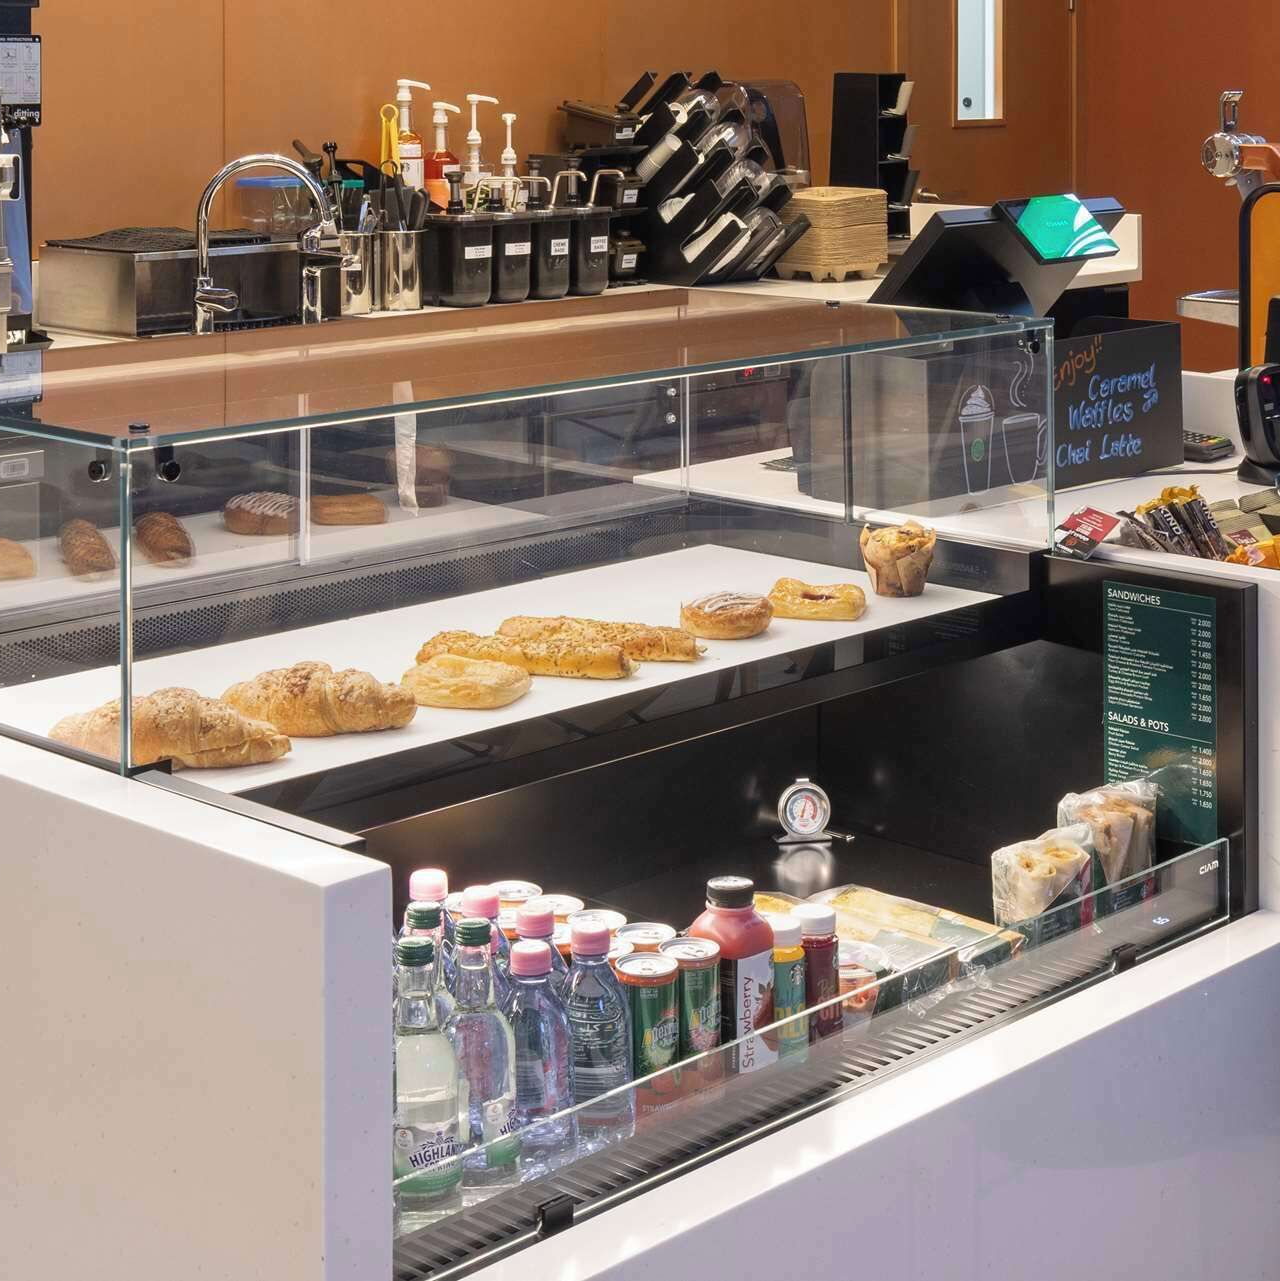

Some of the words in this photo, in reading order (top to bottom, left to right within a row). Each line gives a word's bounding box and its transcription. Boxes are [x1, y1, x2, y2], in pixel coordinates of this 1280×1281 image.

[14, 109, 40, 119] ditting
[1089, 360, 1156, 401] Caramel
[1069, 398, 1134, 431] Waffles
[1056, 439, 1091, 468] Chai
[1100, 434, 1142, 460] Latte
[1159, 505, 1182, 535] KIND
[1199, 499, 1218, 529] KIND
[1107, 588, 1160, 605] SANDWICHES
[1108, 711, 1138, 725] SALADS
[1140, 718, 1146, 727] &
[1148, 720, 1169, 732] POTS
[742, 976, 754, 1069] Strawberry
